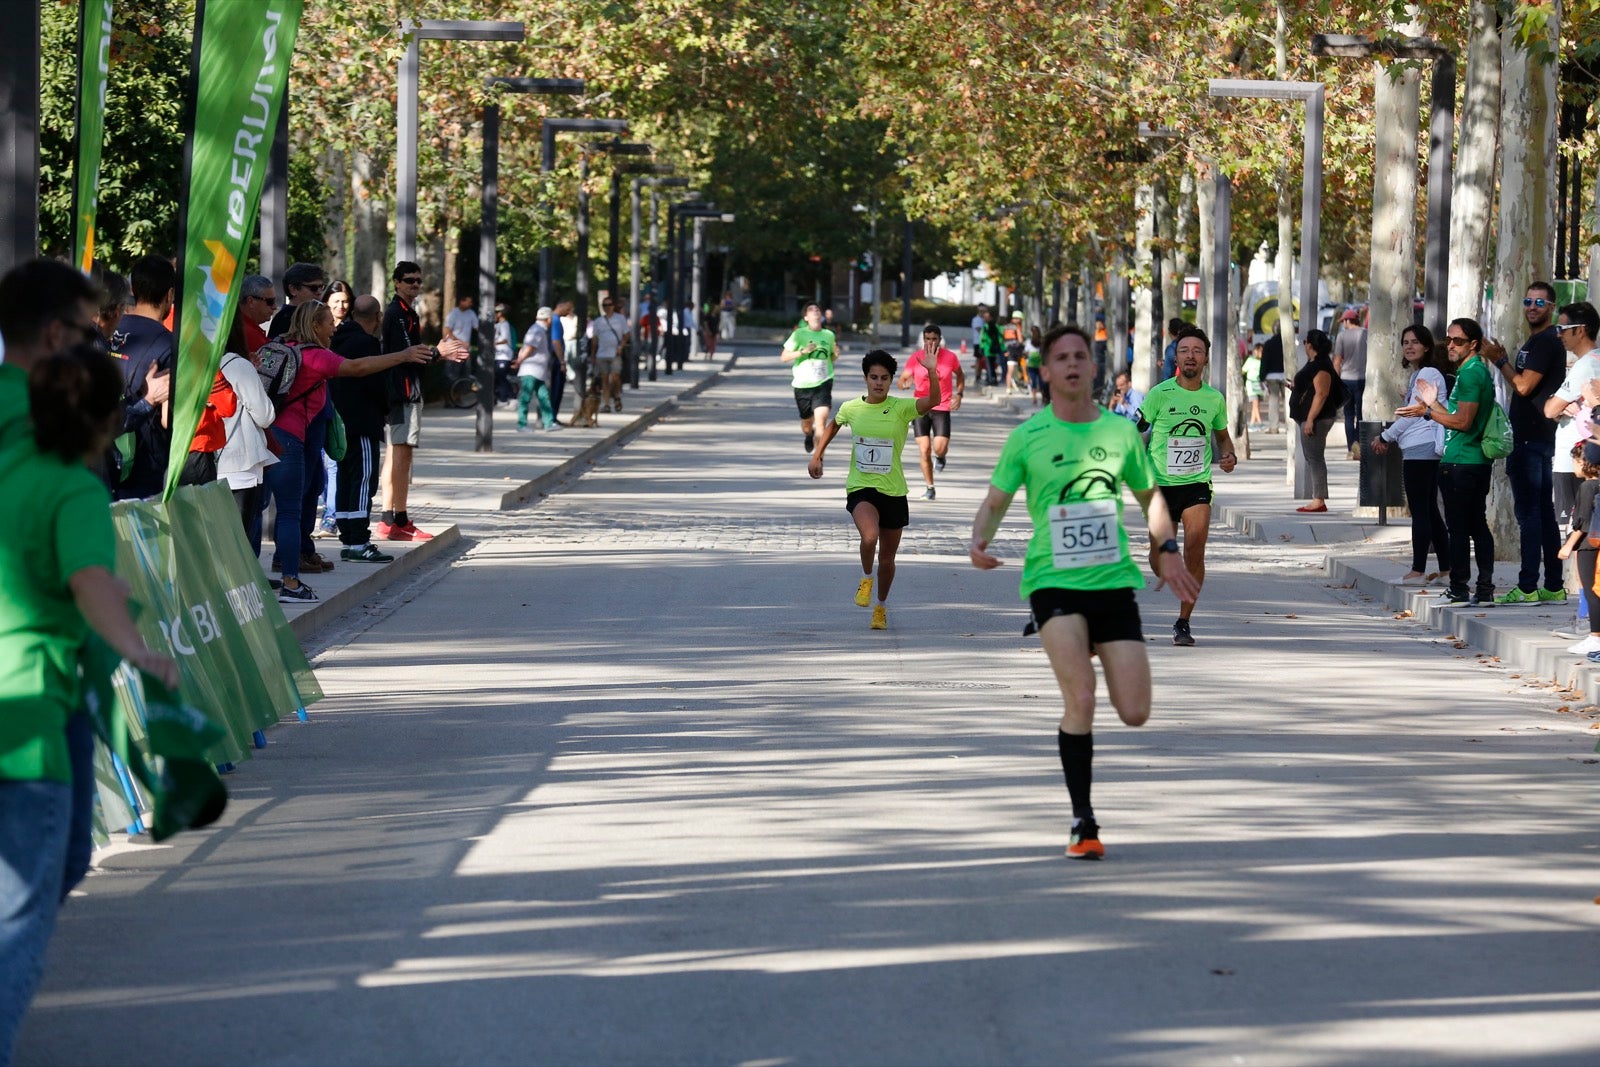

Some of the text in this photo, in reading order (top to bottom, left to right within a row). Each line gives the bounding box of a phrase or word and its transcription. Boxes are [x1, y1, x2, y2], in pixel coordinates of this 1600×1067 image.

[868, 449, 875, 463] 1
[1173, 449, 1201, 465] 728
[1062, 523, 1109, 549] 554
